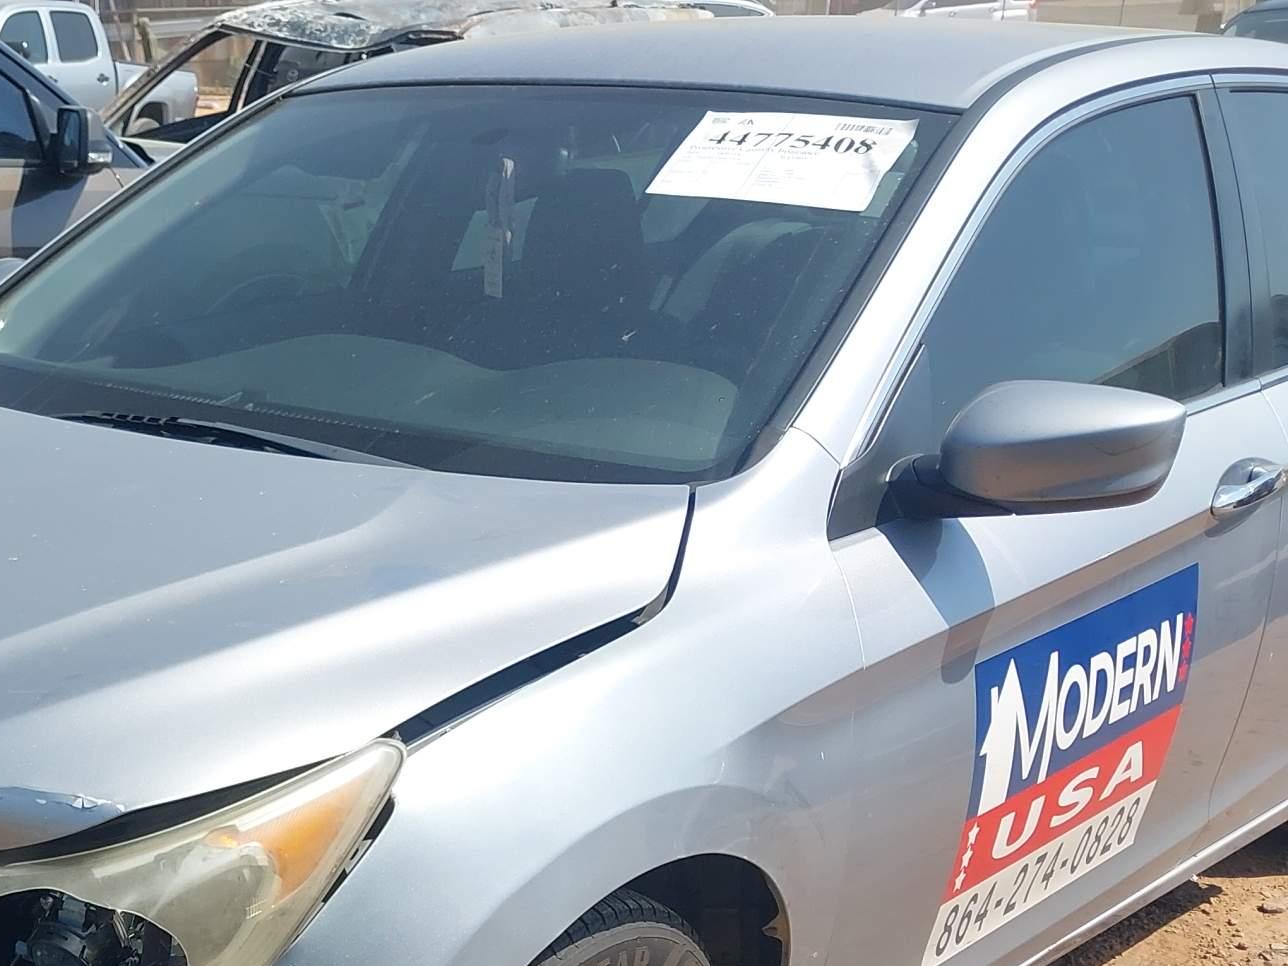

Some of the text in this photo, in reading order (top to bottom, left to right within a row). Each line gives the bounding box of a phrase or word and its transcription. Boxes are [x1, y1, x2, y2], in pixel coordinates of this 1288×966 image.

[708, 130, 878, 155] 44775408
[992, 741, 1145, 860] USA
[935, 796, 1140, 957] 864-274-0828
